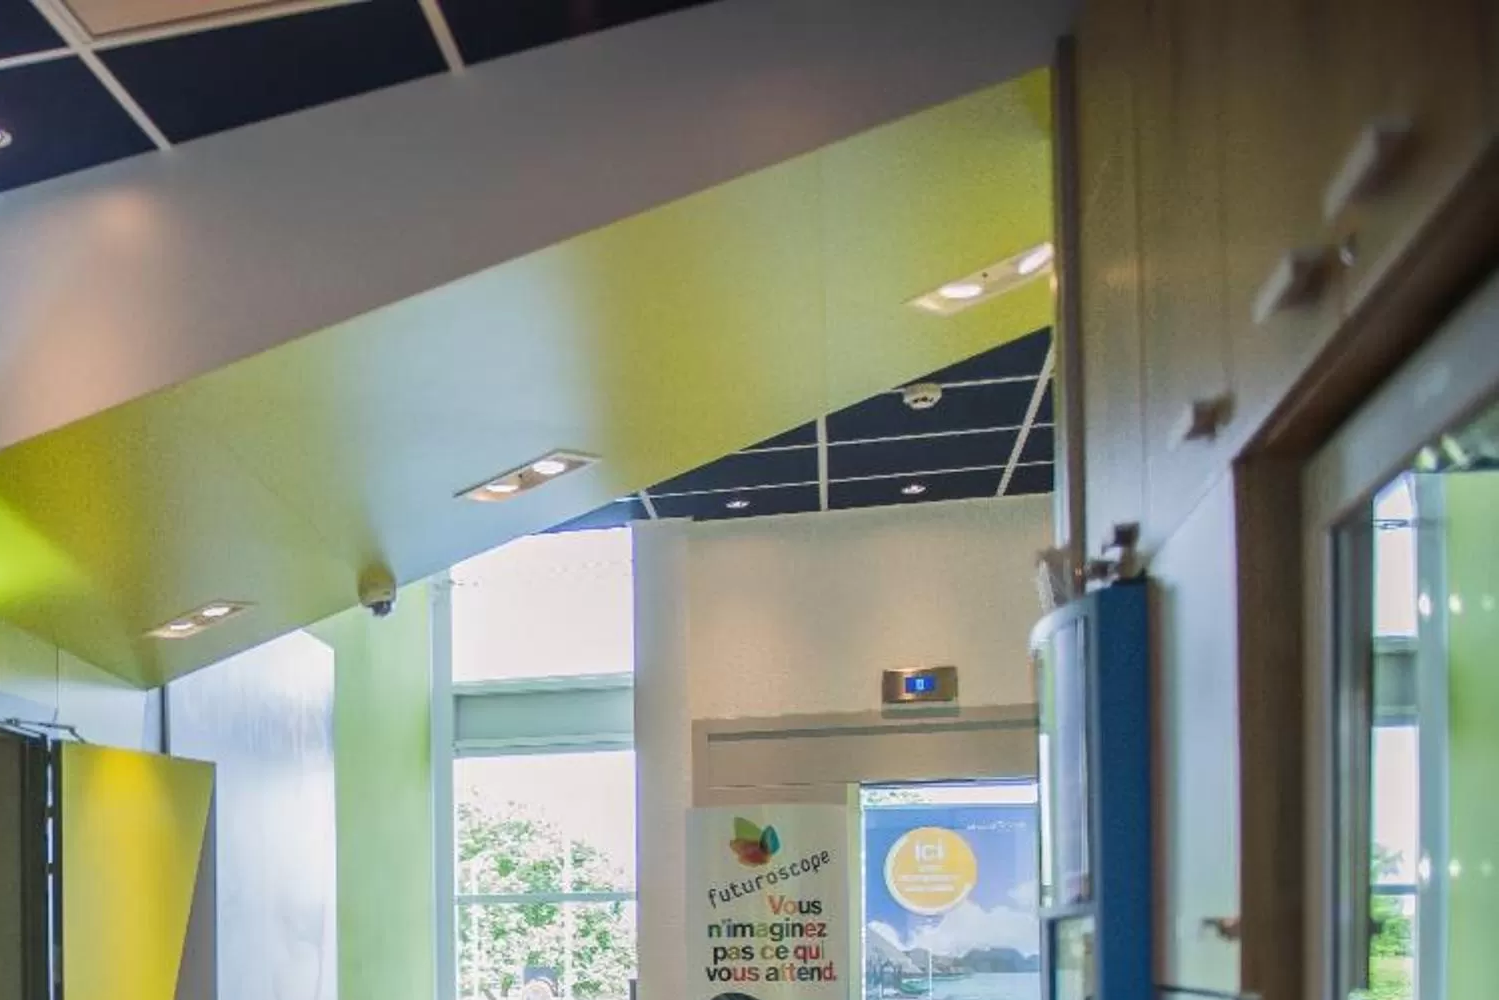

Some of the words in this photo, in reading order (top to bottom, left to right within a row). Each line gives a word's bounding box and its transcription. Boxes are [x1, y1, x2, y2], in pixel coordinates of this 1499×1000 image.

[708, 851, 830, 909] futuroscope
[767, 895, 822, 915] Vous
[708, 918, 827, 942] n'imaginez
[713, 945, 755, 965] pas
[760, 944, 789, 960] ce
[793, 940, 824, 964] qui
[706, 966, 760, 982] vous
